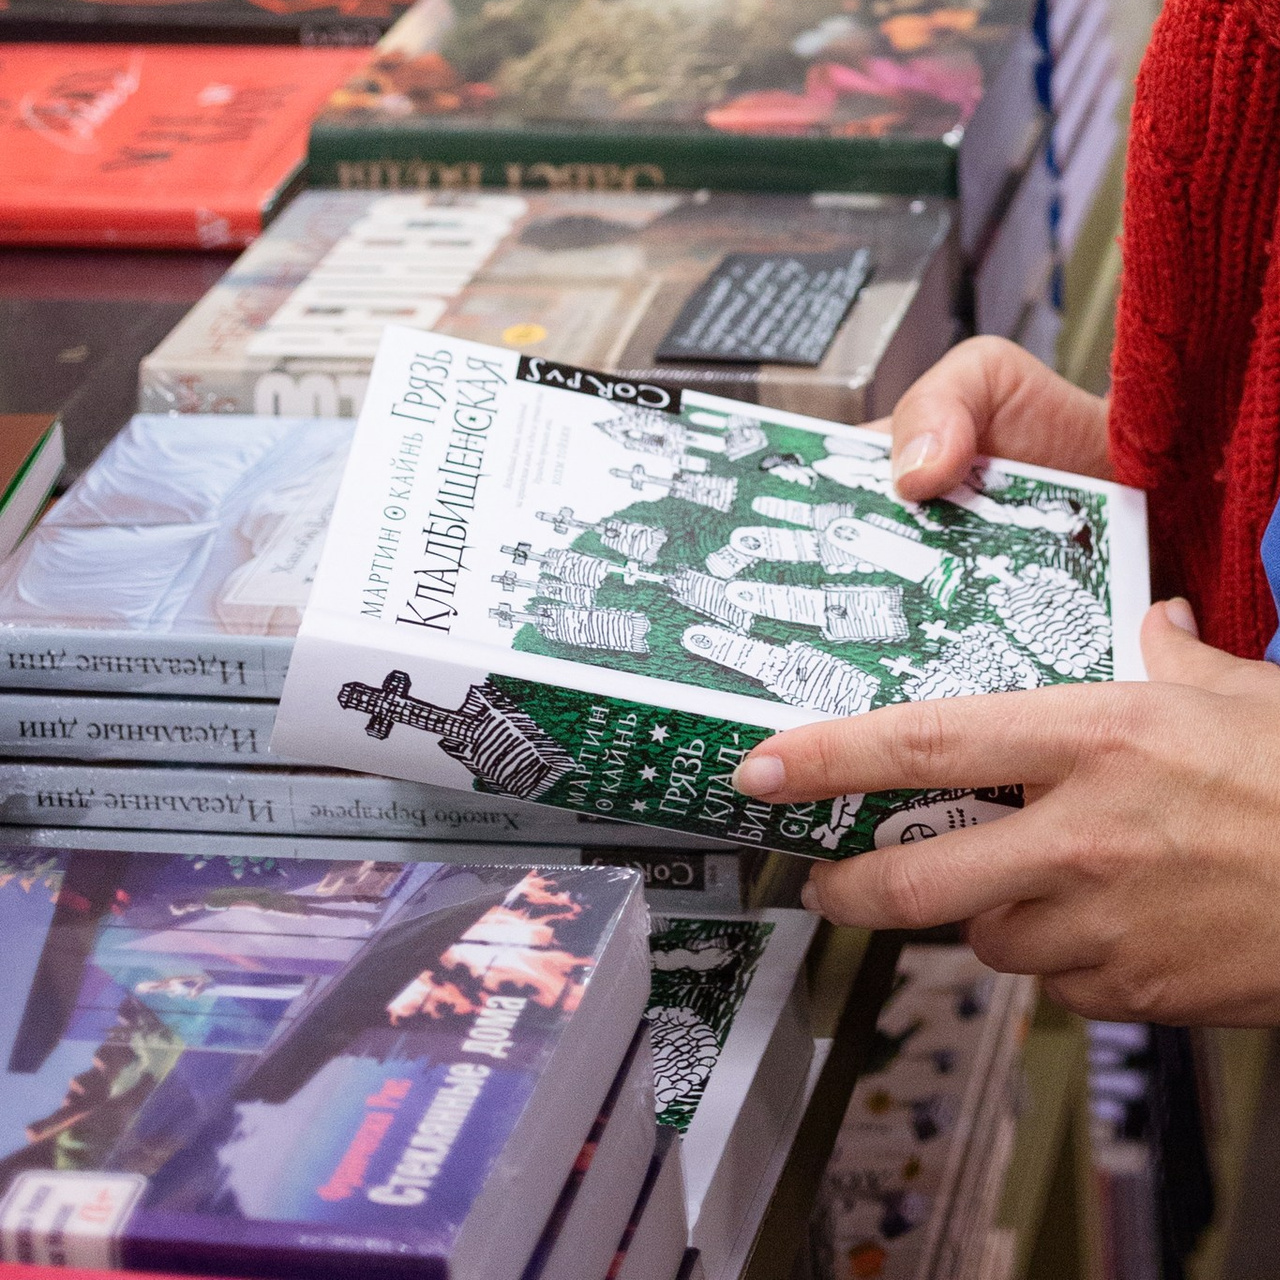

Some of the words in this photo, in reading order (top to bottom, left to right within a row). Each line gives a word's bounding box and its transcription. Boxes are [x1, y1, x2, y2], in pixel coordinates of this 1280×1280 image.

[360, 526, 402, 619] МАРТИН
[388, 432, 424, 501] КАЙНЬ
[7, 648, 67, 672] дни
[77, 651, 248, 686] Идеальные
[19, 717, 78, 741] дни
[87, 721, 260, 755] Идеальные
[566, 705, 610, 806] МАРТИН
[600, 712, 638, 795] КАЙНЬ
[658, 738, 707, 817] ГРЯЗЬ
[37, 785, 96, 810] дни
[104, 790, 276, 824] Идеальные
[434, 806, 520, 832] Хакобо
[366, 1062, 493, 1207] Стеклянные
[460, 994, 528, 1059] дома
